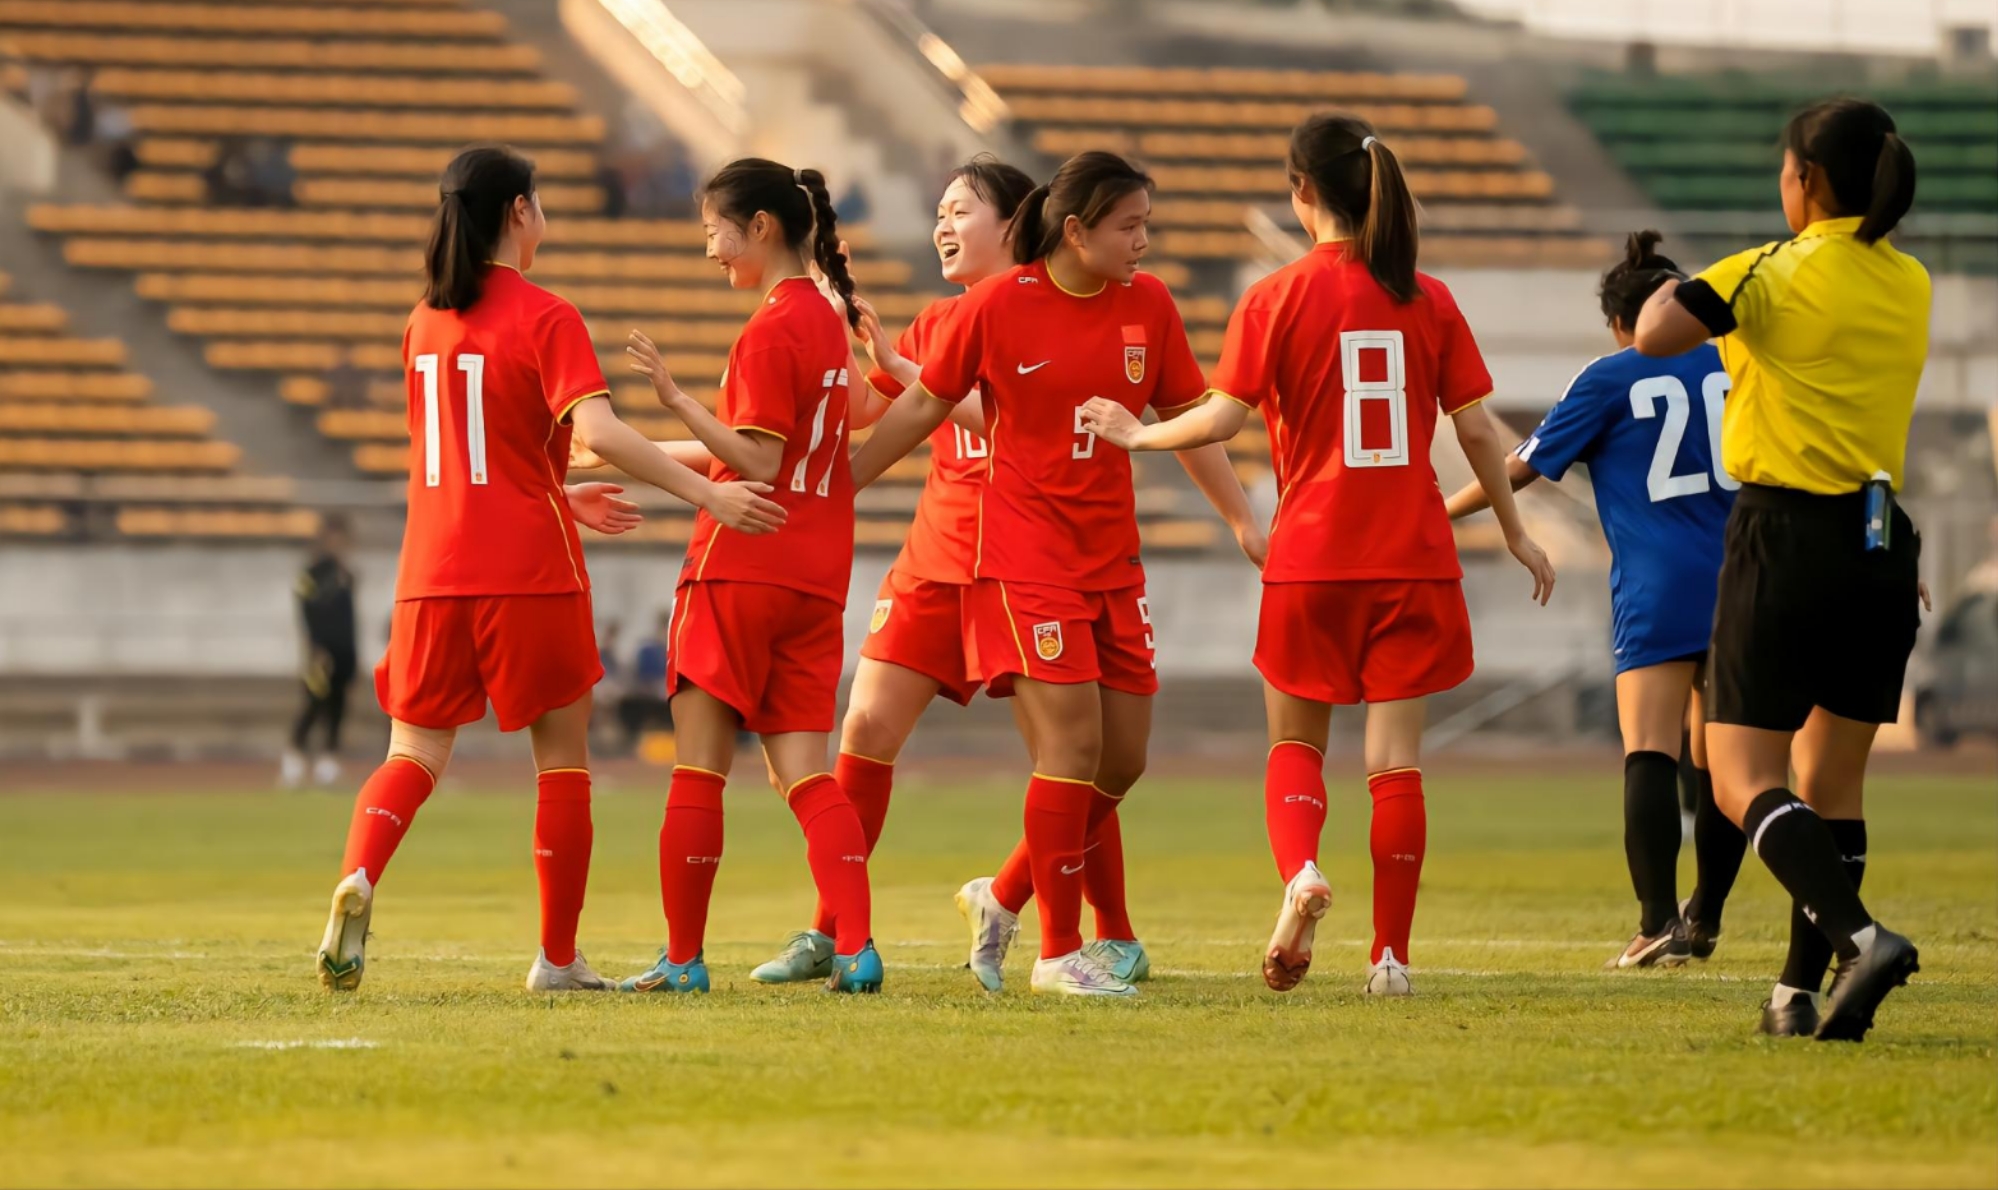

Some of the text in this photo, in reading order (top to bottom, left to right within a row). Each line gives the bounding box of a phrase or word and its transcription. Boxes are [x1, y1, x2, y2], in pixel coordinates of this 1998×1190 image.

[414, 353, 488, 487] 11
[953, 421, 988, 460] 10
[1340, 331, 1409, 467] 8
[1630, 374, 1740, 504] 20
[365, 807, 402, 827] CFA
[1284, 794, 1325, 810] CFA
